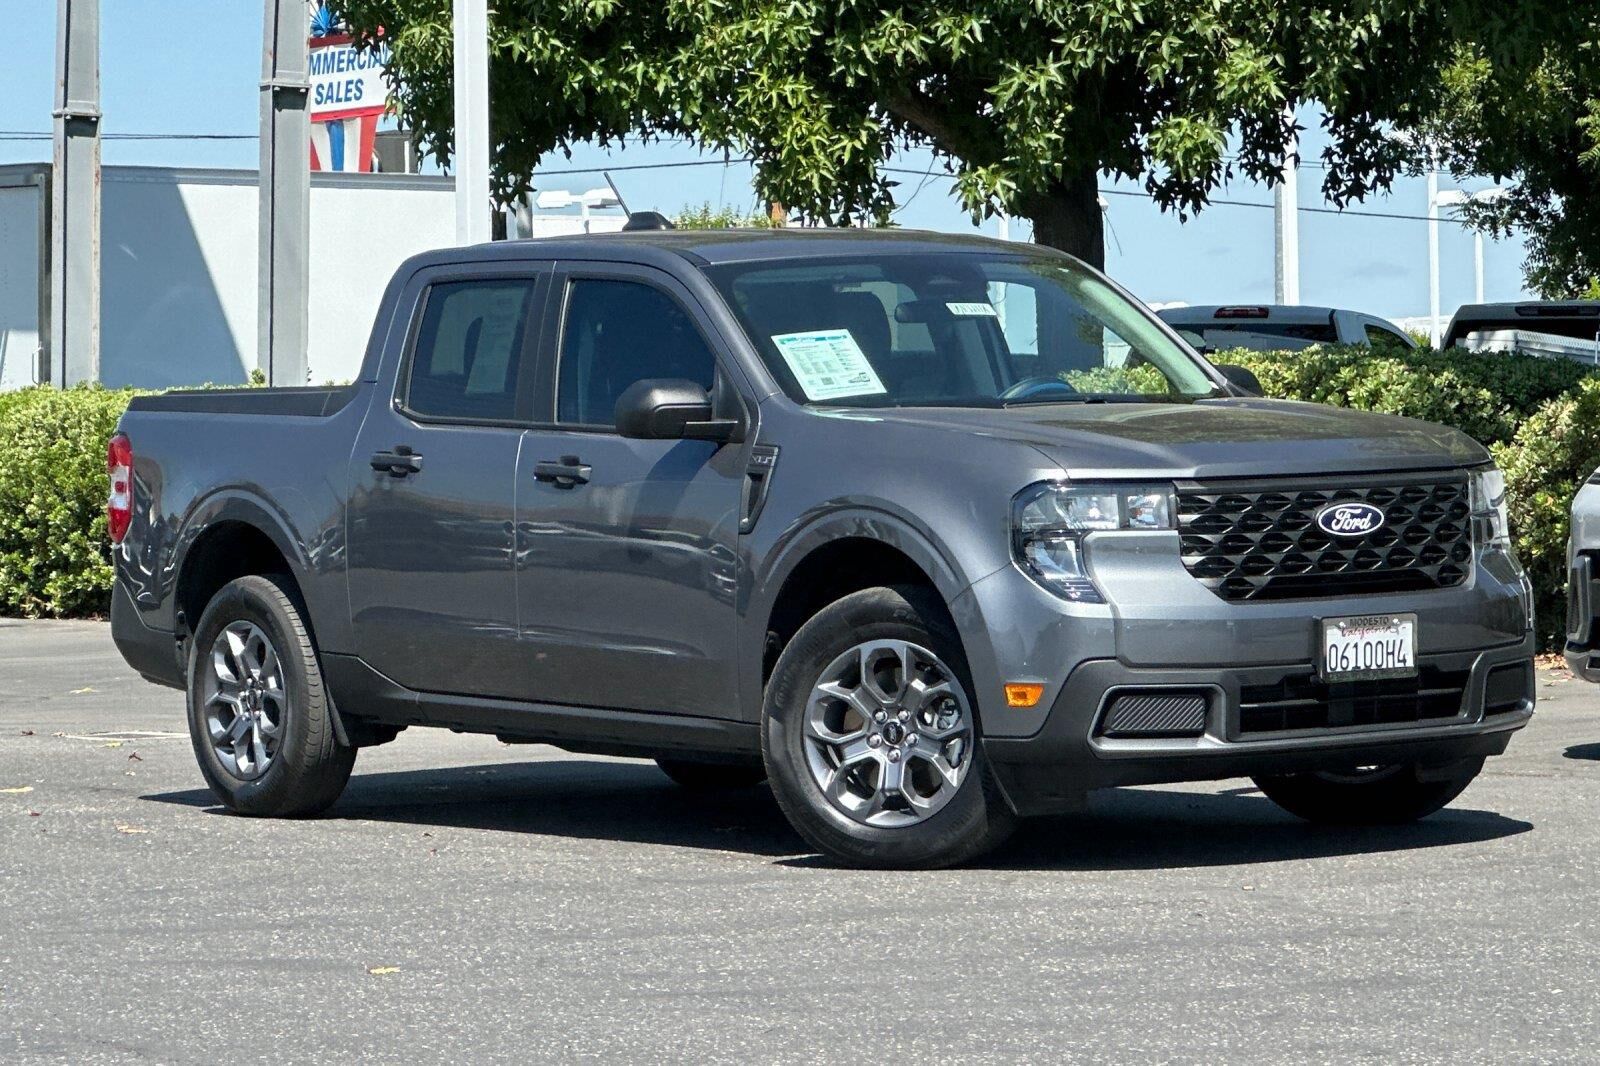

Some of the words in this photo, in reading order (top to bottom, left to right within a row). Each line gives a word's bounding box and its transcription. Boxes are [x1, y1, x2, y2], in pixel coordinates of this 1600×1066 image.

[315, 78, 364, 105] SALES
[1331, 508, 1373, 530] Ford
[1349, 616, 1389, 627] MODESTO
[1328, 638, 1407, 672] 06100H4
